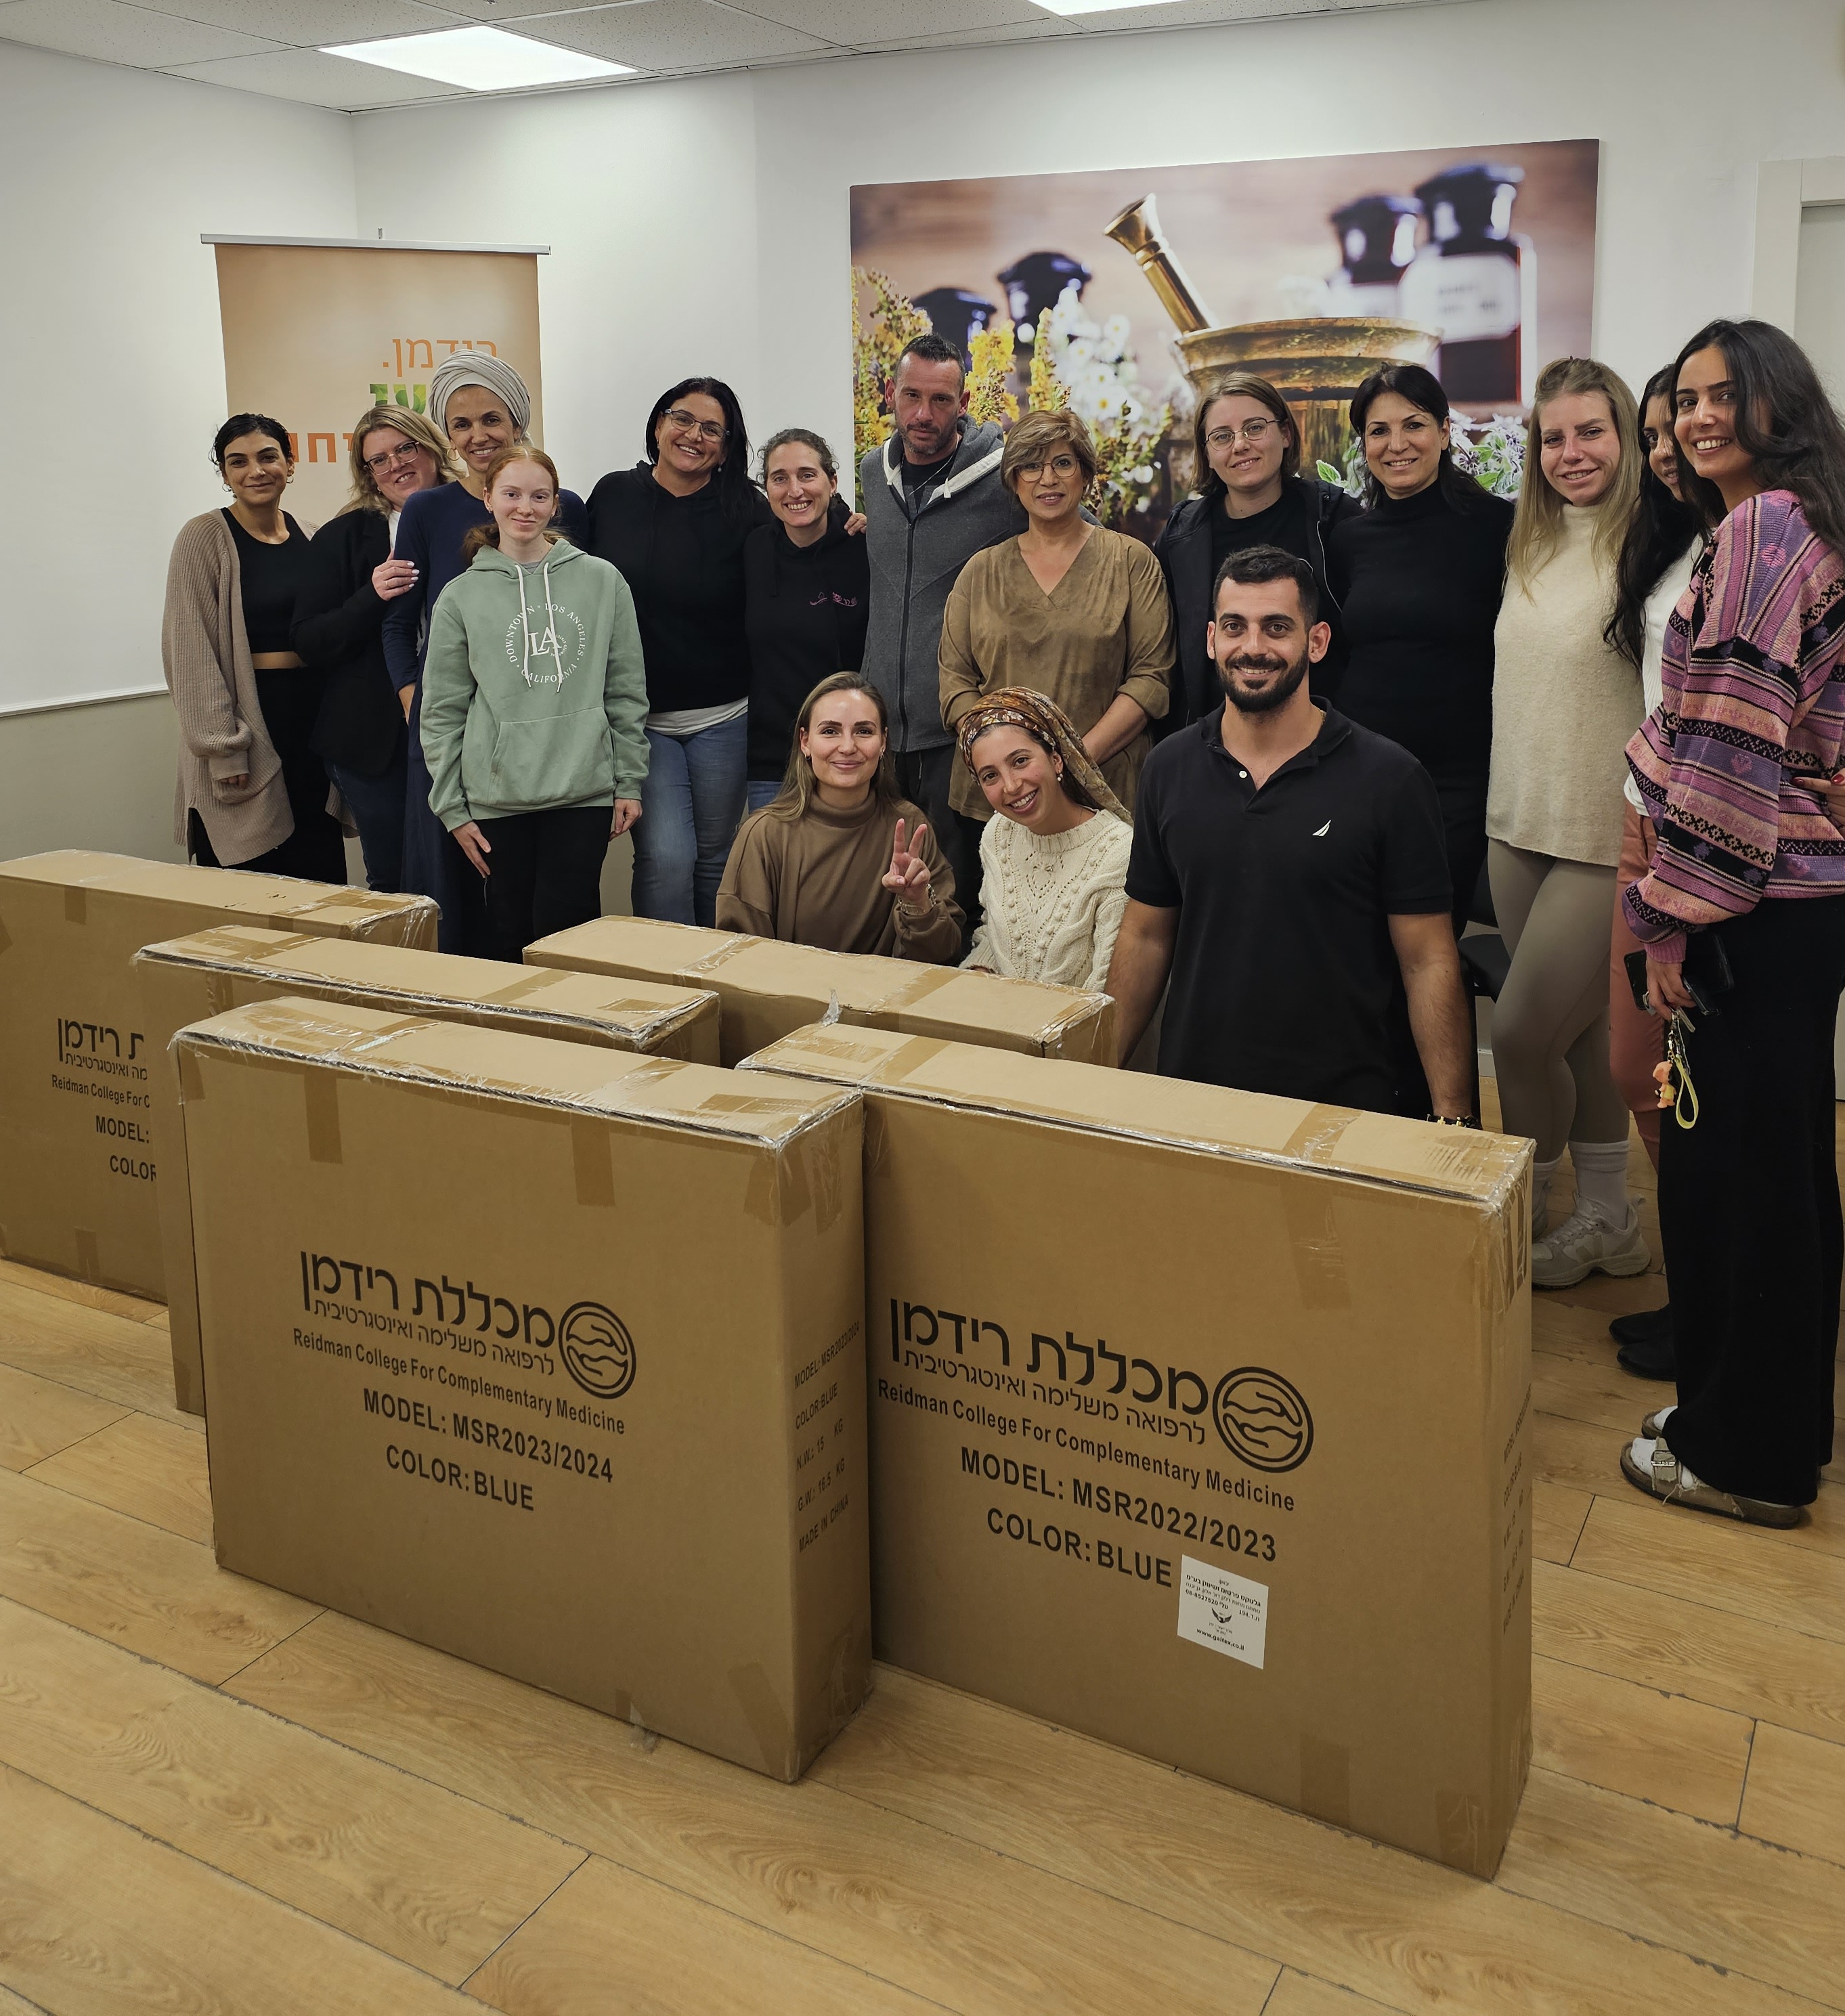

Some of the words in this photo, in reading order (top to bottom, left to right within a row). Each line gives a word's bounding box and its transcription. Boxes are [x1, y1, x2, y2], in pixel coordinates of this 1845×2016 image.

[528, 626, 562, 656] LA
[545, 603, 565, 613] LOS
[567, 612, 586, 656] ANGELES
[58, 1018, 120, 1061] רידמן
[65, 1053, 129, 1077] ואינטגרטיבית
[51, 1074, 89, 1095] Reidman
[91, 1083, 125, 1105] College
[127, 1091, 142, 1106] For
[96, 1115, 149, 1143] MODEL:
[301, 1251, 399, 1311] רידמן
[314, 1300, 412, 1339] ואינטגרטיבית
[412, 1275, 555, 1348] מכללת
[888, 1296, 1010, 1366] רידמן
[418, 1325, 486, 1357] משלימה
[492, 1344, 554, 1376] לרפואה
[293, 1328, 352, 1359] Reidman
[356, 1344, 407, 1376] College
[411, 1358, 434, 1381] For
[438, 1365, 552, 1418] Complementary
[557, 1397, 624, 1434] Medicine
[904, 1349, 1025, 1397] ואינטגרטיבית
[1026, 1331, 1209, 1415] מכללת
[1033, 1382, 1119, 1421] משלימה
[364, 1388, 446, 1434] MODEL:
[453, 1413, 613, 1483] MSR2023/2024
[834, 1418, 843, 1437] KG
[877, 1376, 948, 1415] Reidman
[953, 1399, 1017, 1434] College
[1022, 1418, 1051, 1443] For
[1056, 1428, 1200, 1490] Complementary
[1207, 1468, 1294, 1511] Medicine
[1127, 1407, 1205, 1445] לרפואה
[836, 1458, 845, 1476] KG
[961, 1446, 1063, 1500] MODEL:
[1072, 1478, 1276, 1562] MSR2022/2023
[799, 1523, 819, 1553] MADE
[821, 1514, 827, 1532] IN
